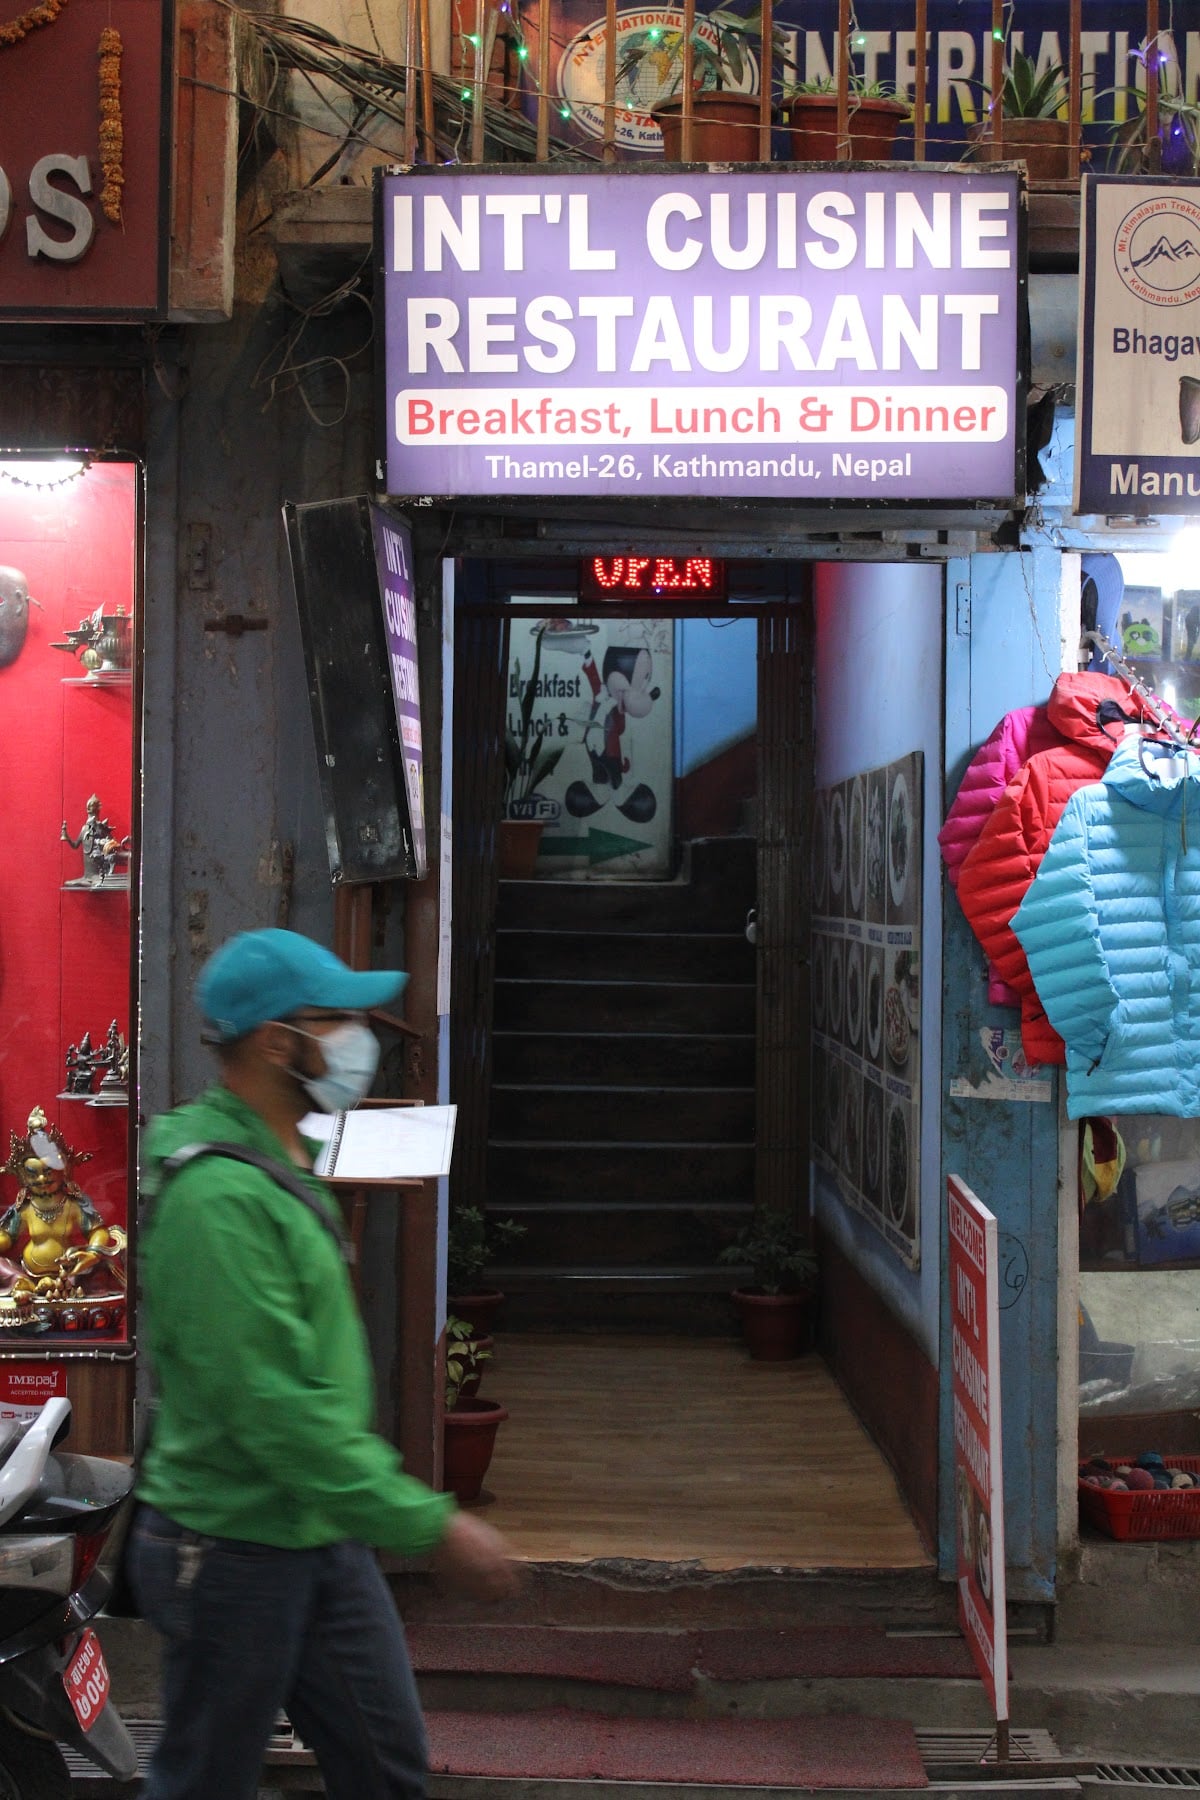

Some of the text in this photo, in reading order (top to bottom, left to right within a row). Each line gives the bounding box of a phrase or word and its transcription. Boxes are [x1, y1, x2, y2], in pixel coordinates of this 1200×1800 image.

[0, 153, 95, 265] S
[1122, 201, 1168, 235] Himalayan
[393, 191, 1011, 272] INT'L CUISINE
[406, 294, 999, 374] RESTAURANT
[407, 396, 997, 438] Breakfast, Lunch & Dinner
[485, 453, 912, 482] Thamel-26, Kathmandu, Nepal
[593, 557, 713, 588] OPEN
[557, 712, 569, 737] &
